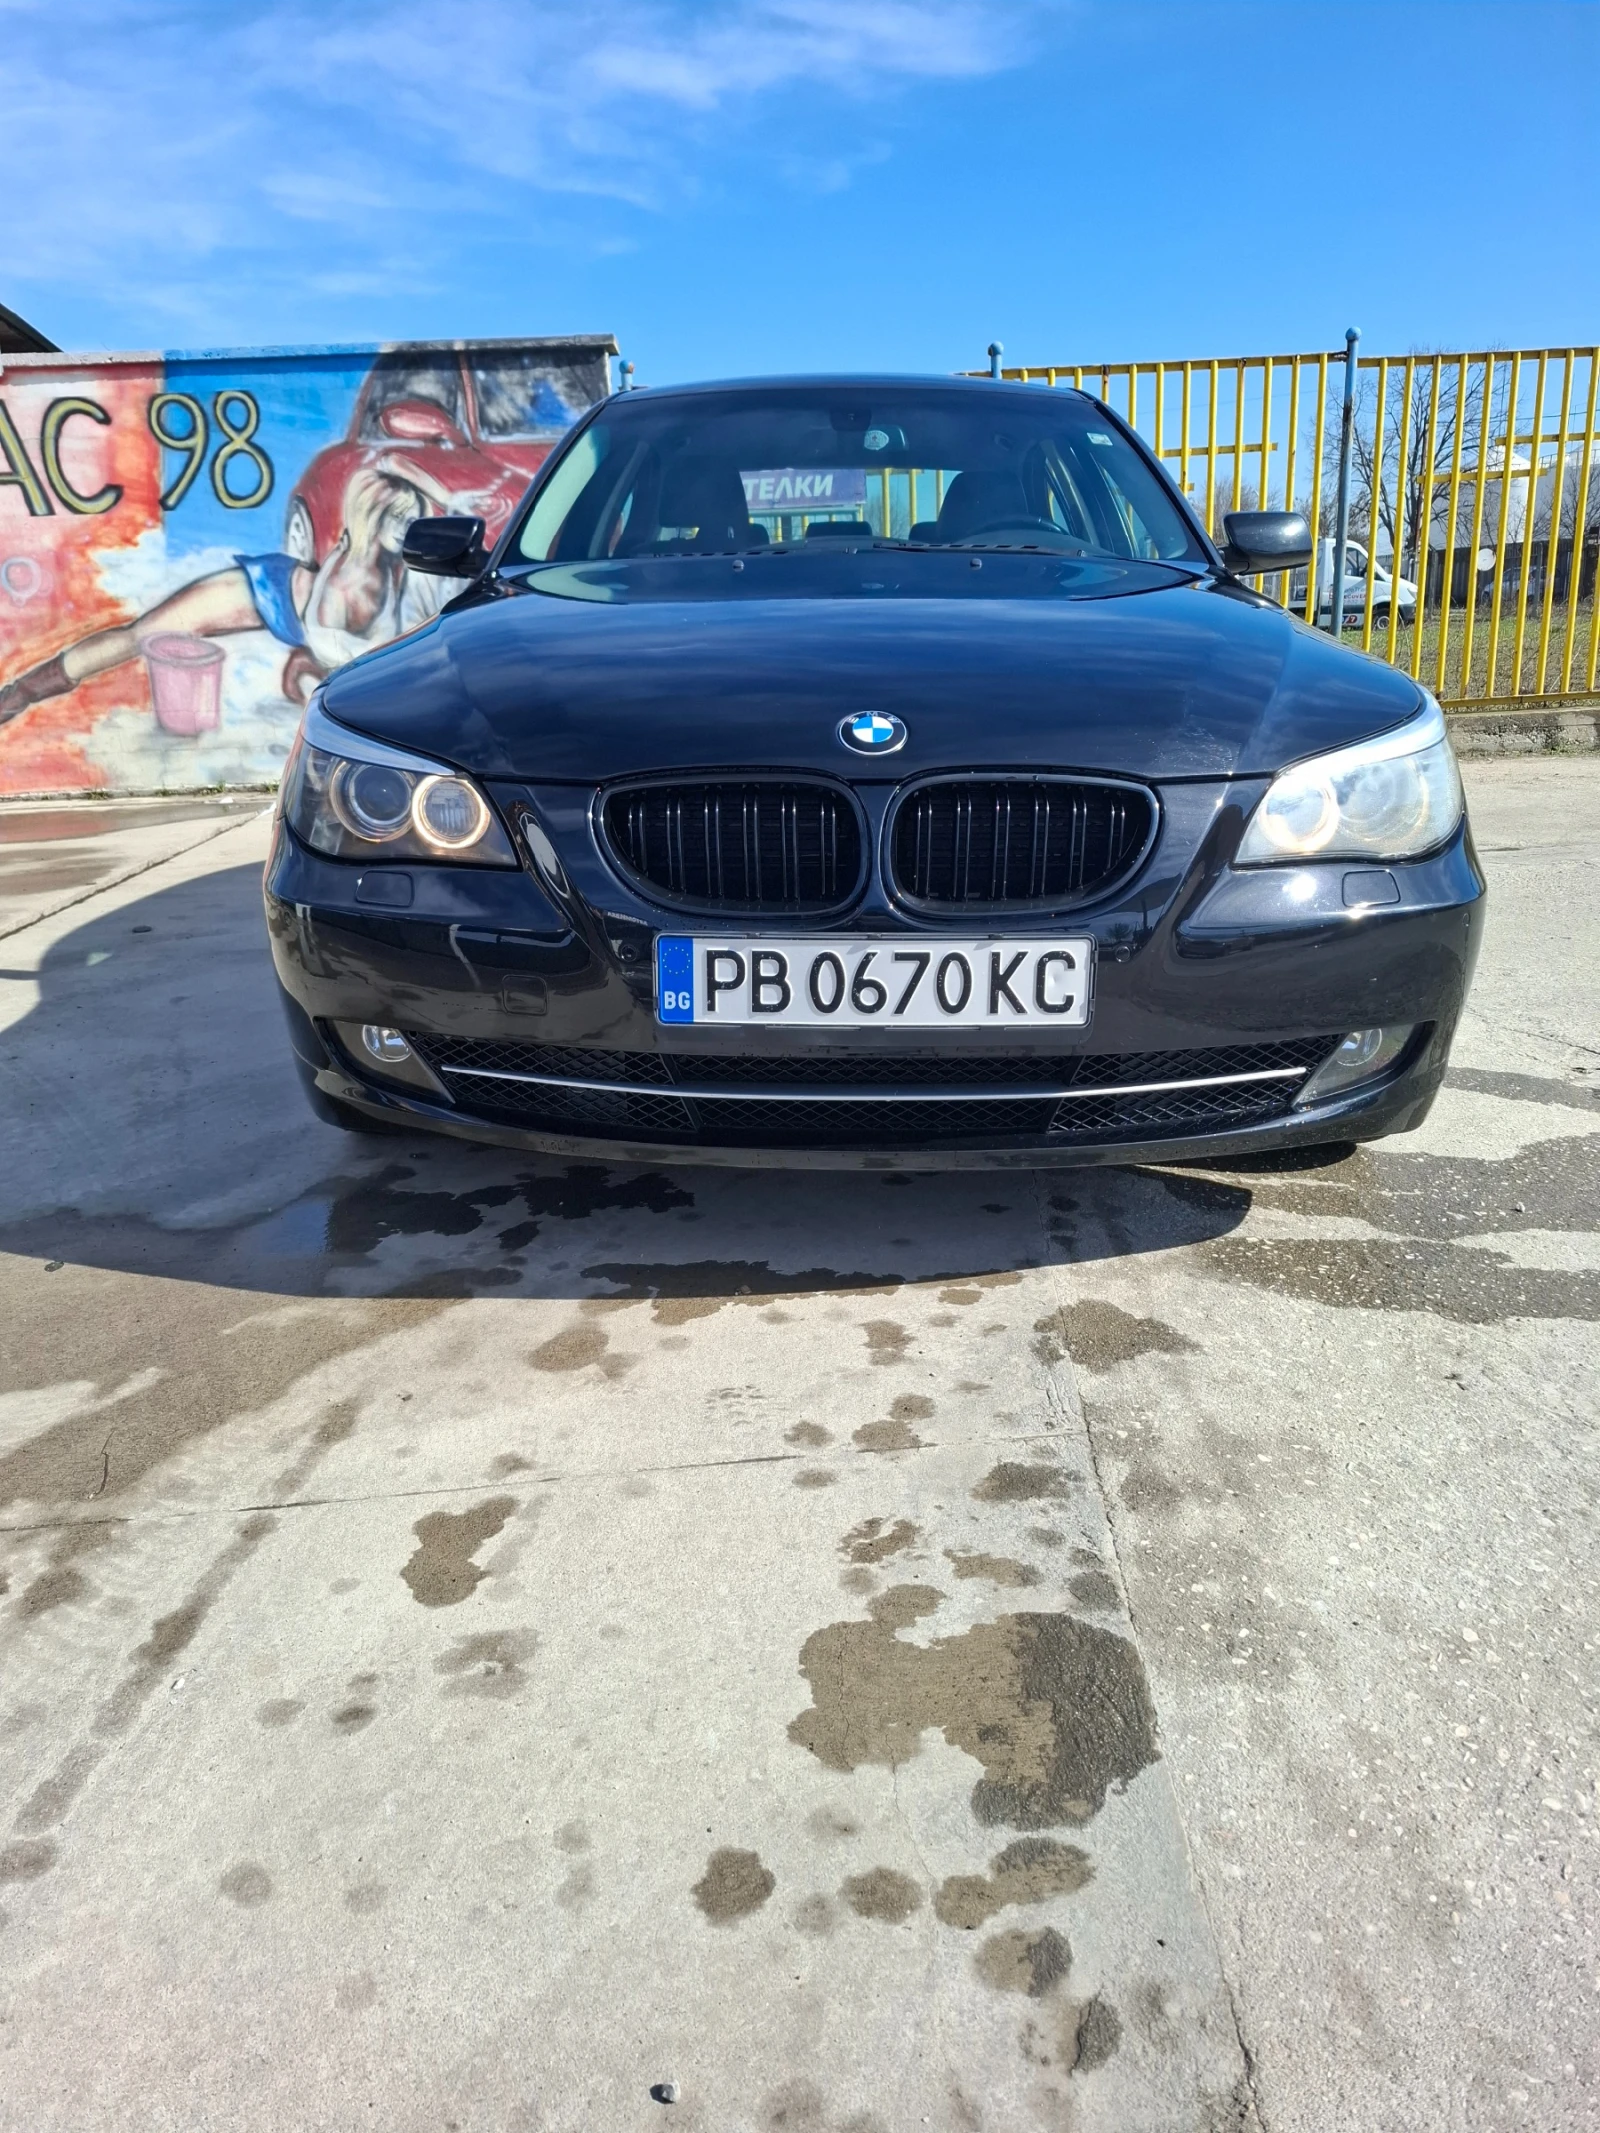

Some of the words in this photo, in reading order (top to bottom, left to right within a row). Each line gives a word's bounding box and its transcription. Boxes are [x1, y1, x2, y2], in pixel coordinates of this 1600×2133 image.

[148, 390, 274, 511] 98
[663, 990, 691, 1010] BG
[705, 949, 791, 1013] PB
[809, 951, 972, 1014] 0670
[989, 950, 1076, 1014] KC
